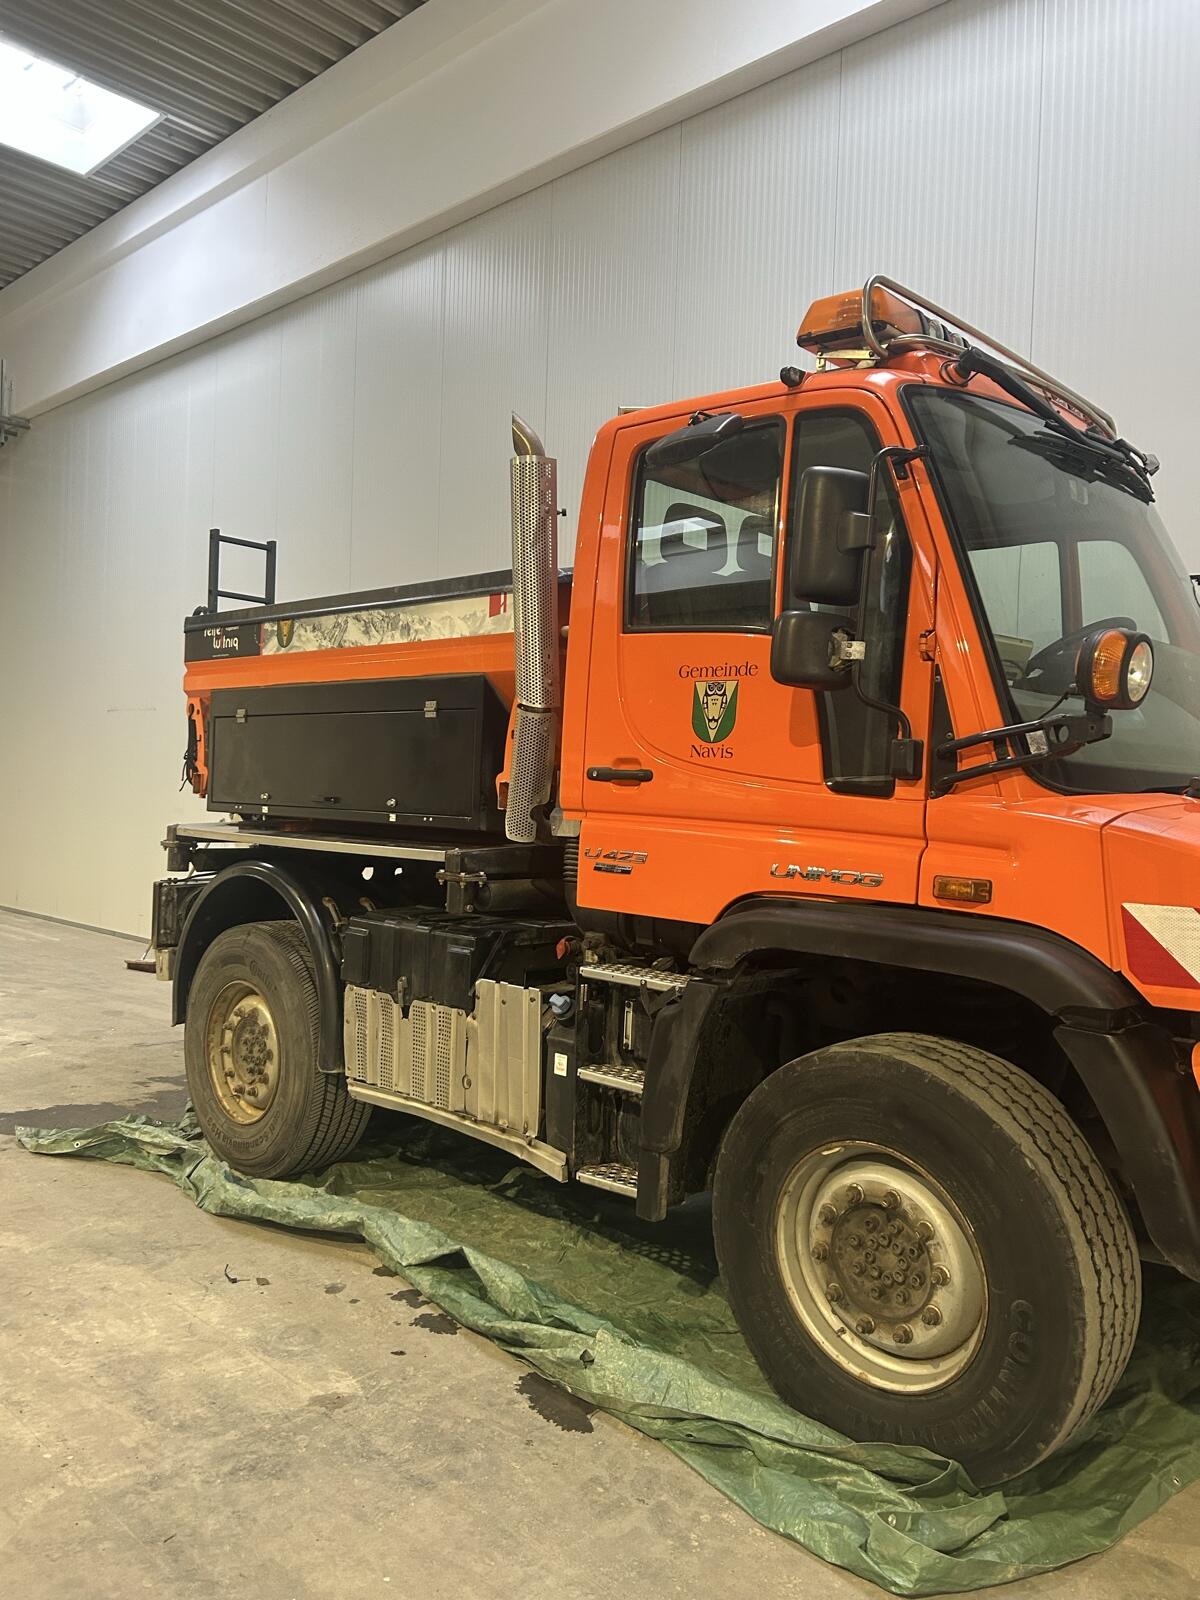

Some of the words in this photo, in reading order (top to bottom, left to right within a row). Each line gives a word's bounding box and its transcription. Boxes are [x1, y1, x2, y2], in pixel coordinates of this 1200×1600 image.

[678, 661, 759, 679] Gemeinde
[689, 744, 734, 759] Navis
[584, 847, 602, 859] U
[769, 863, 884, 887] UNIMOG
